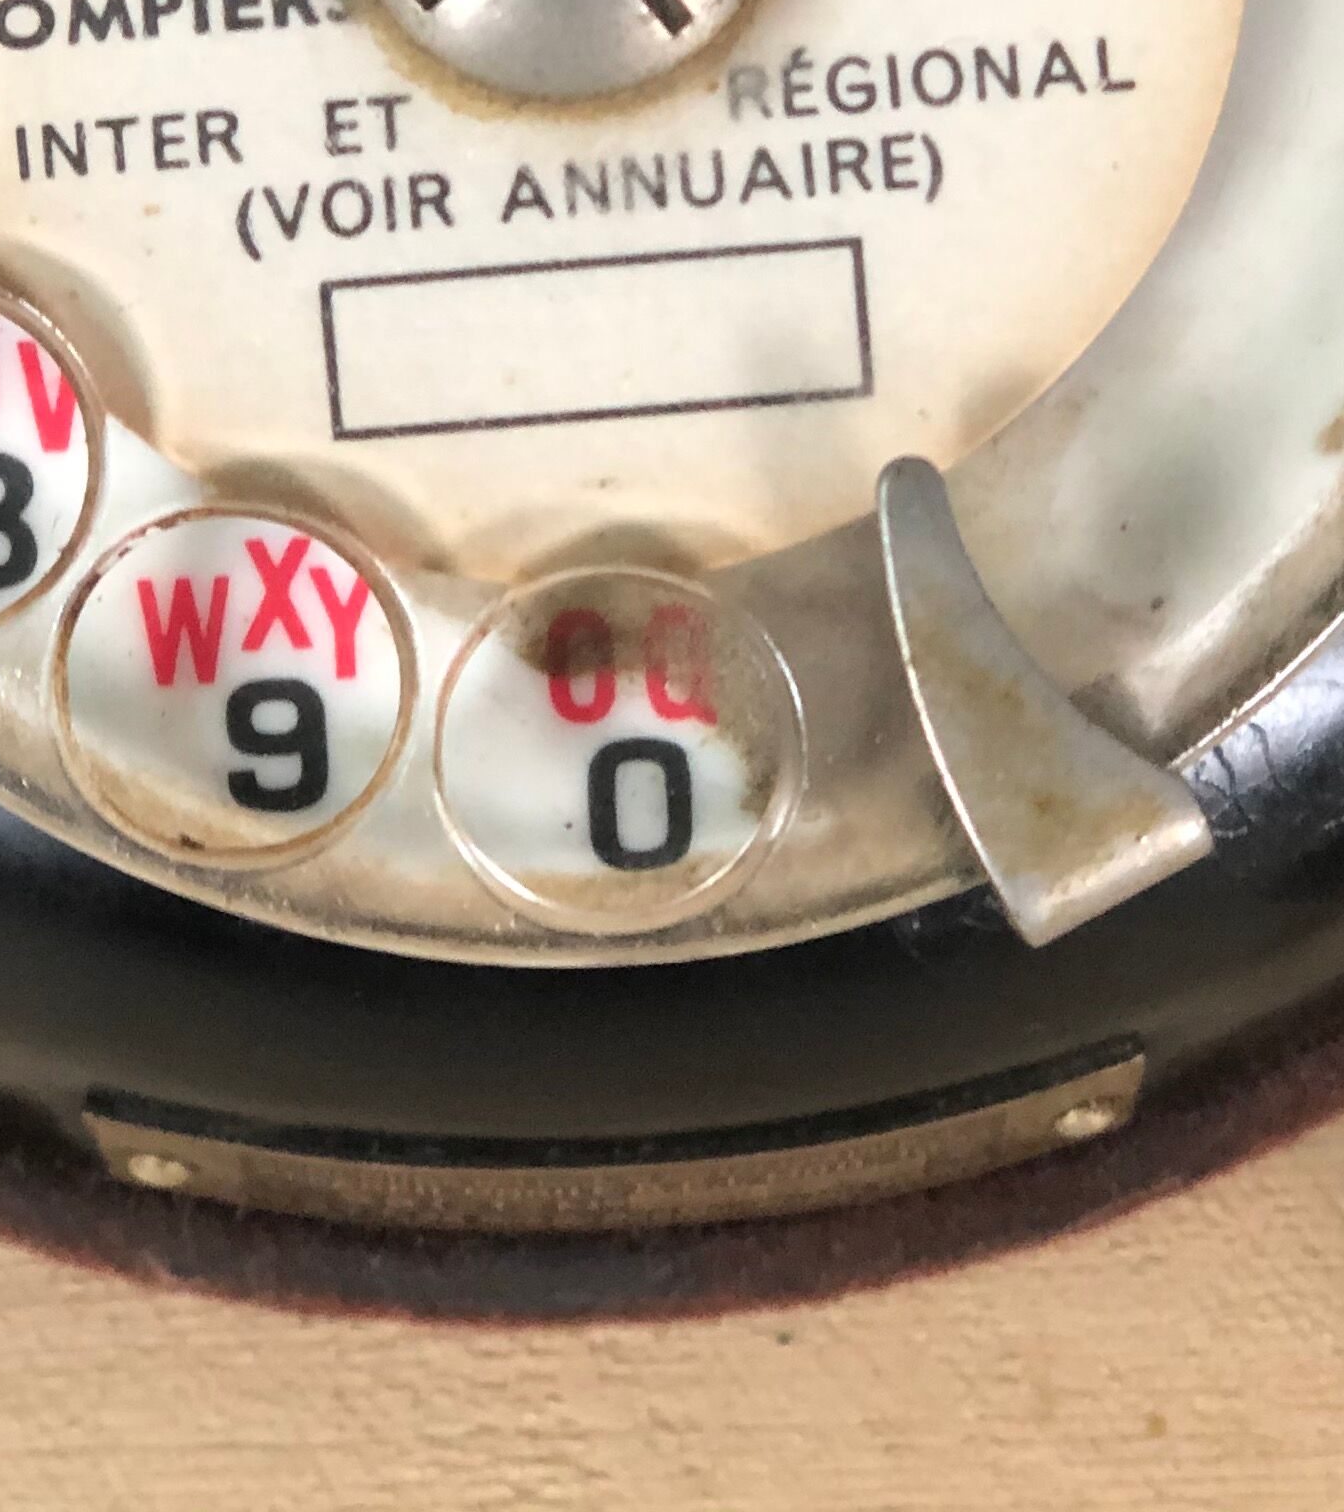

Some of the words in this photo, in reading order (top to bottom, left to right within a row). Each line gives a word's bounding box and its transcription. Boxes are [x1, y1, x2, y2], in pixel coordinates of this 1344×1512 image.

[14, 109, 243, 181] INTER
[323, 94, 411, 158] ET
[726, 37, 1137, 121] RÉGIONAL
[236, 171, 456, 262] (VOIR
[501, 133, 944, 224] ANNUAIRE)
[136, 536, 371, 688] WXY
[225, 678, 329, 813] 9
[586, 737, 693, 872] 0
